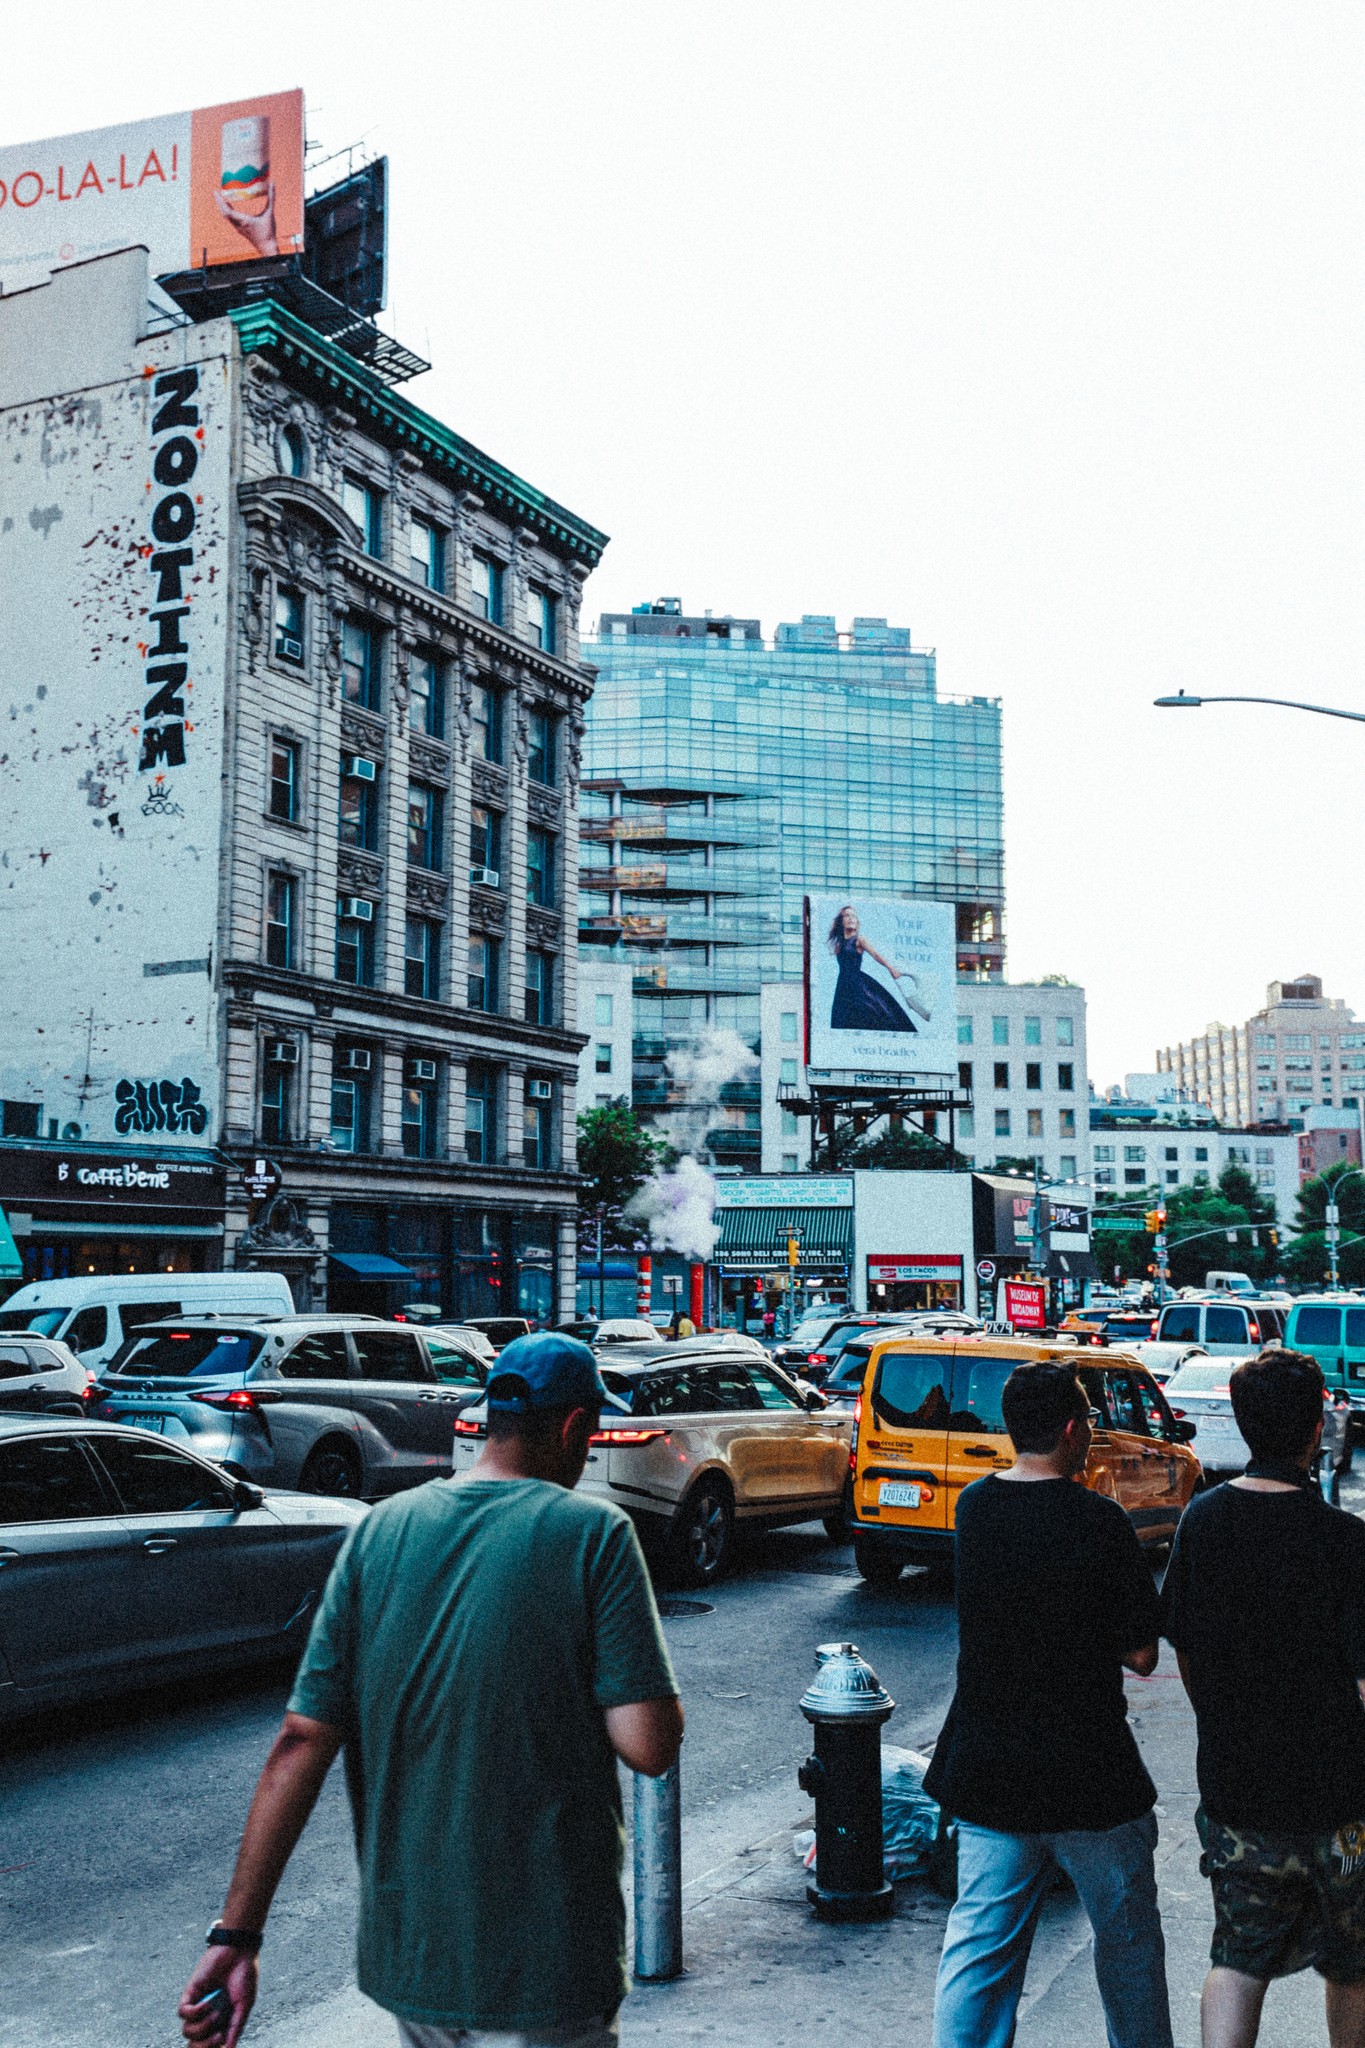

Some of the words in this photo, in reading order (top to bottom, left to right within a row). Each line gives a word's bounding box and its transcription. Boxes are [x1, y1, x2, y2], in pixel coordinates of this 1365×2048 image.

[0, 143, 178, 208] O-LA-LA!
[895, 916, 924, 930] Your
[852, 1046, 876, 1056] vera
[878, 1046, 917, 1057] bradley
[155, 1163, 179, 1172] COFFEE
[179, 1165, 191, 1173] AND
[191, 1166, 214, 1175] WAFFLE
[1009, 1287, 1032, 1302] MUSEUM
[1032, 1291, 1039, 1303] OF
[1010, 1303, 1040, 1317] BROADWAY
[986, 1322, 1012, 1335] 7K79
